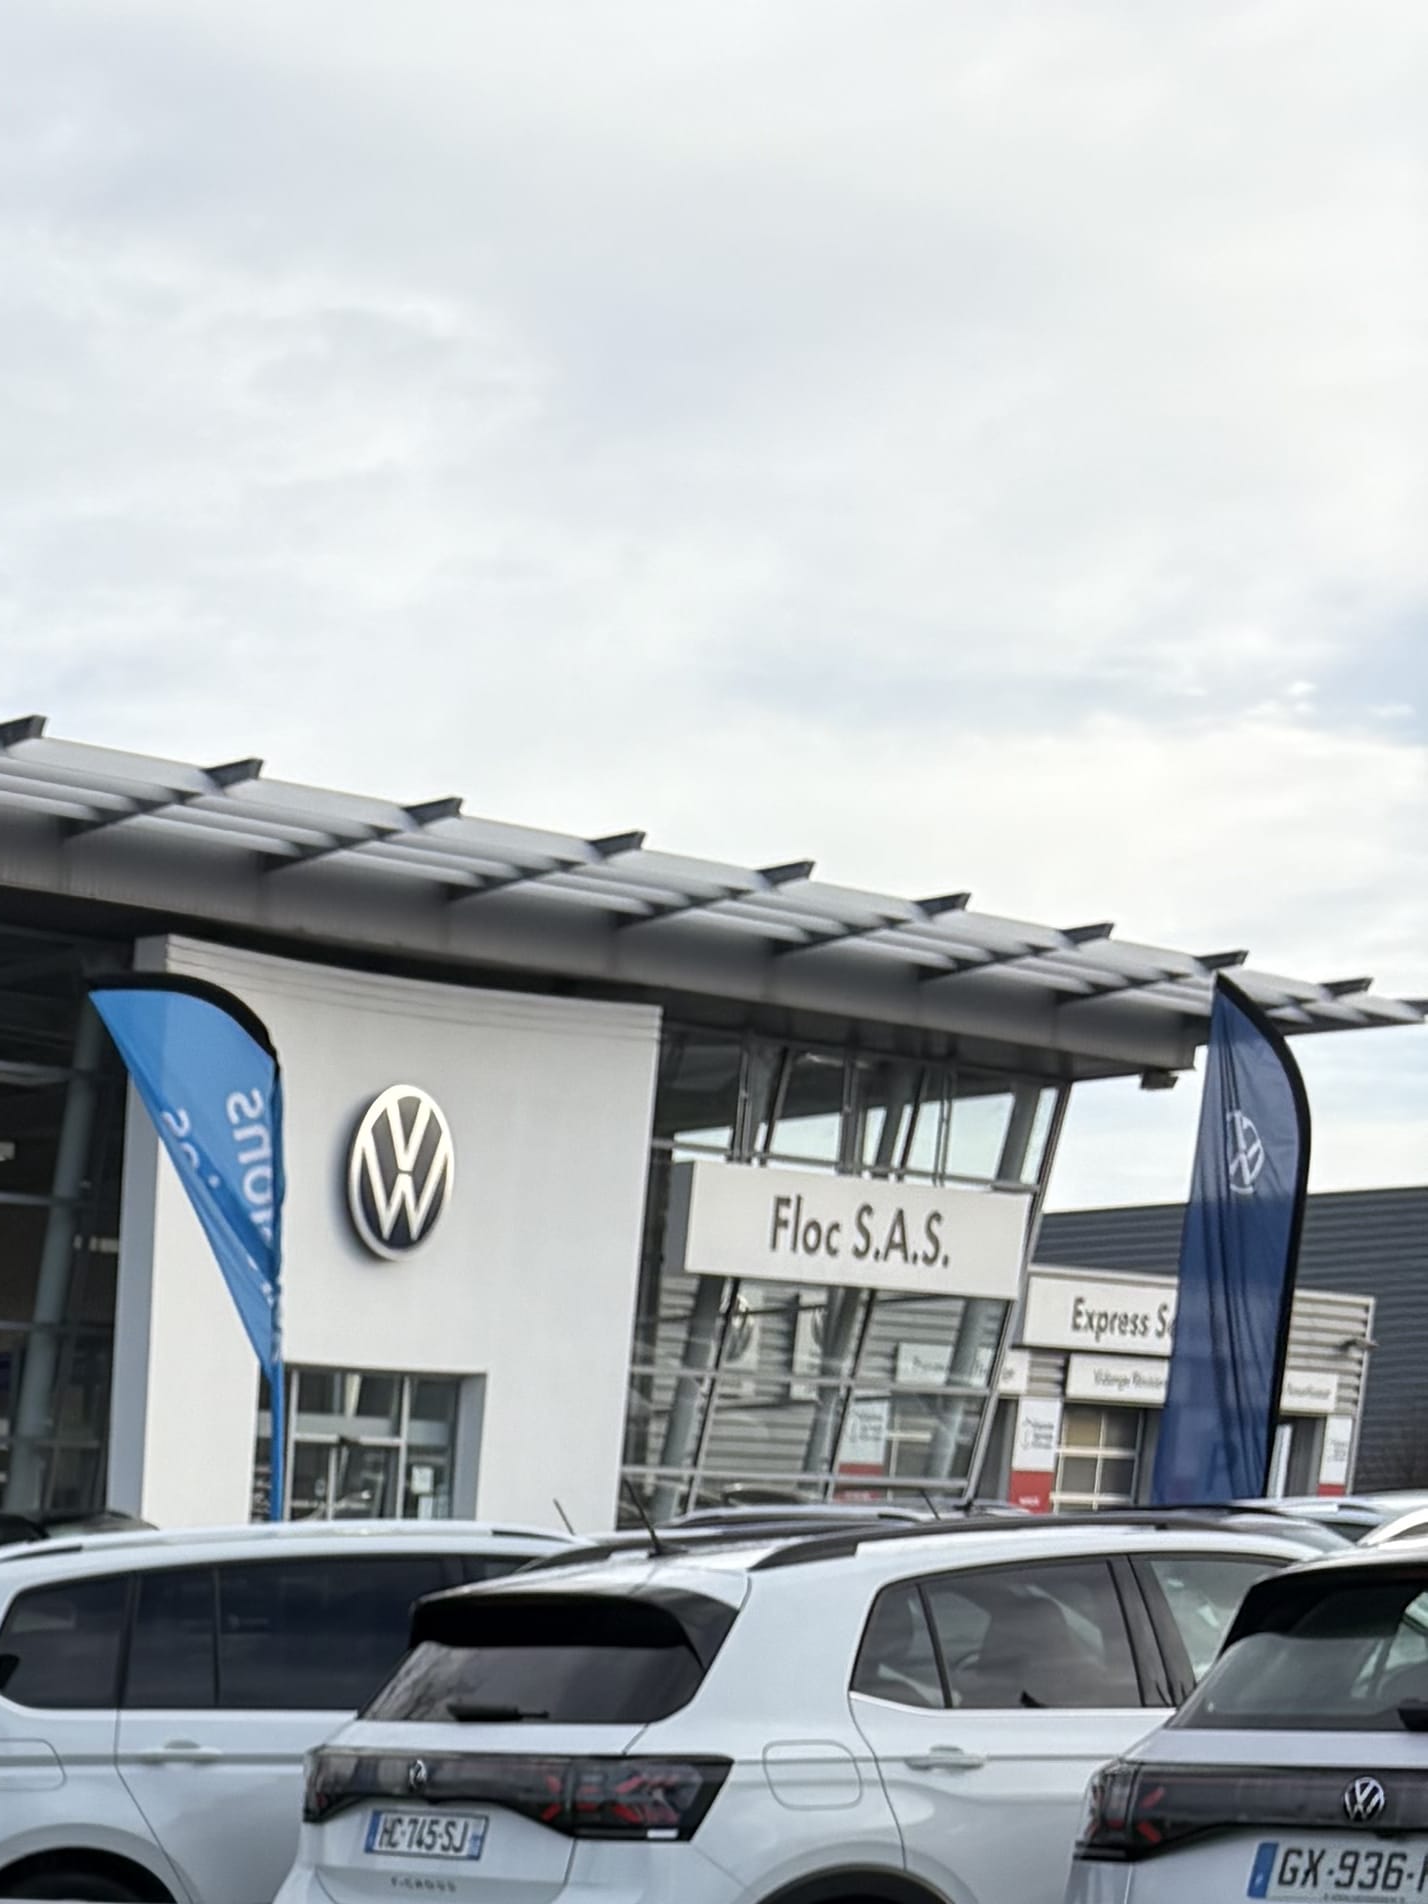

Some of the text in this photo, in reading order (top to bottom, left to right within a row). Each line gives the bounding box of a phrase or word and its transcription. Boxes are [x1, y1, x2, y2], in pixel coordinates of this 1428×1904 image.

[769, 1194, 950, 1268] Floc S.A.S.
[1071, 1296, 1149, 1343] Express
[1277, 1847, 1428, 1893] GX-936-
